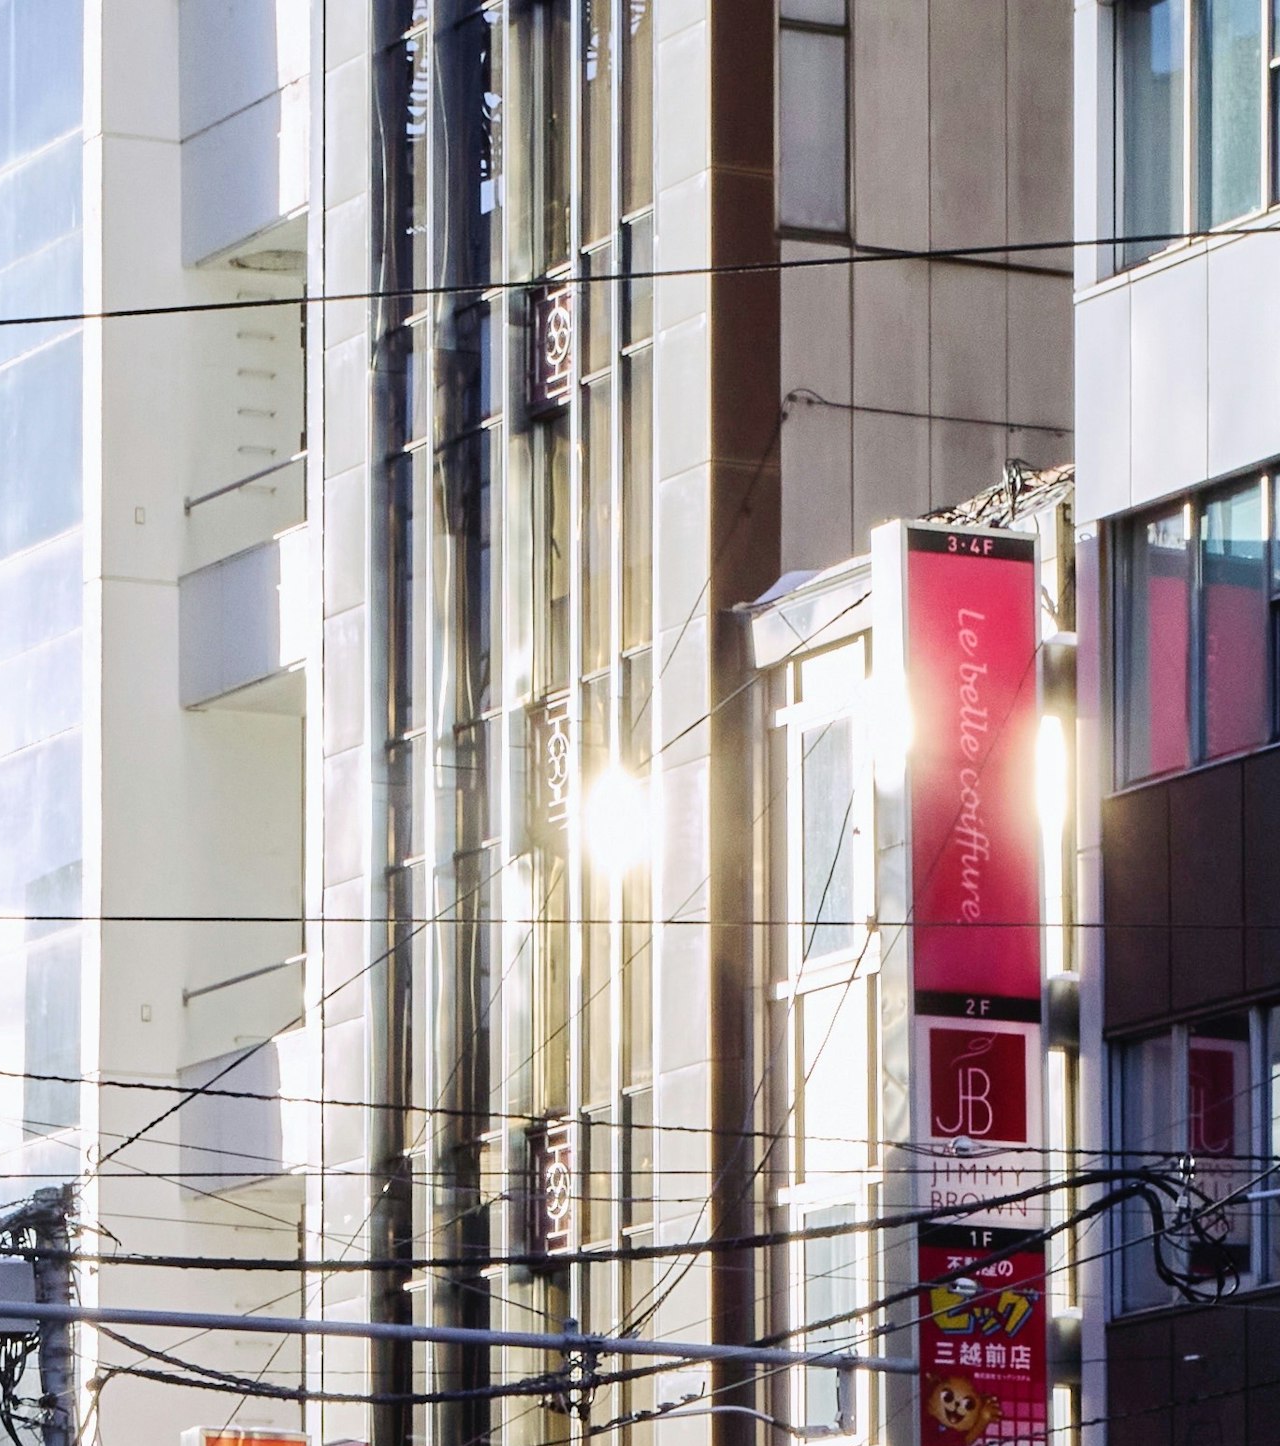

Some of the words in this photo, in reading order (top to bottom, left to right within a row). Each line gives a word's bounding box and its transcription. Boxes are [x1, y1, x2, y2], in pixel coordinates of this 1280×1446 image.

[966, 998, 991, 1015] 2F
[931, 1161, 1025, 1188] JIMMY
[970, 1231, 993, 1248] 1F
[934, 1341, 1031, 1370] 三越前店
